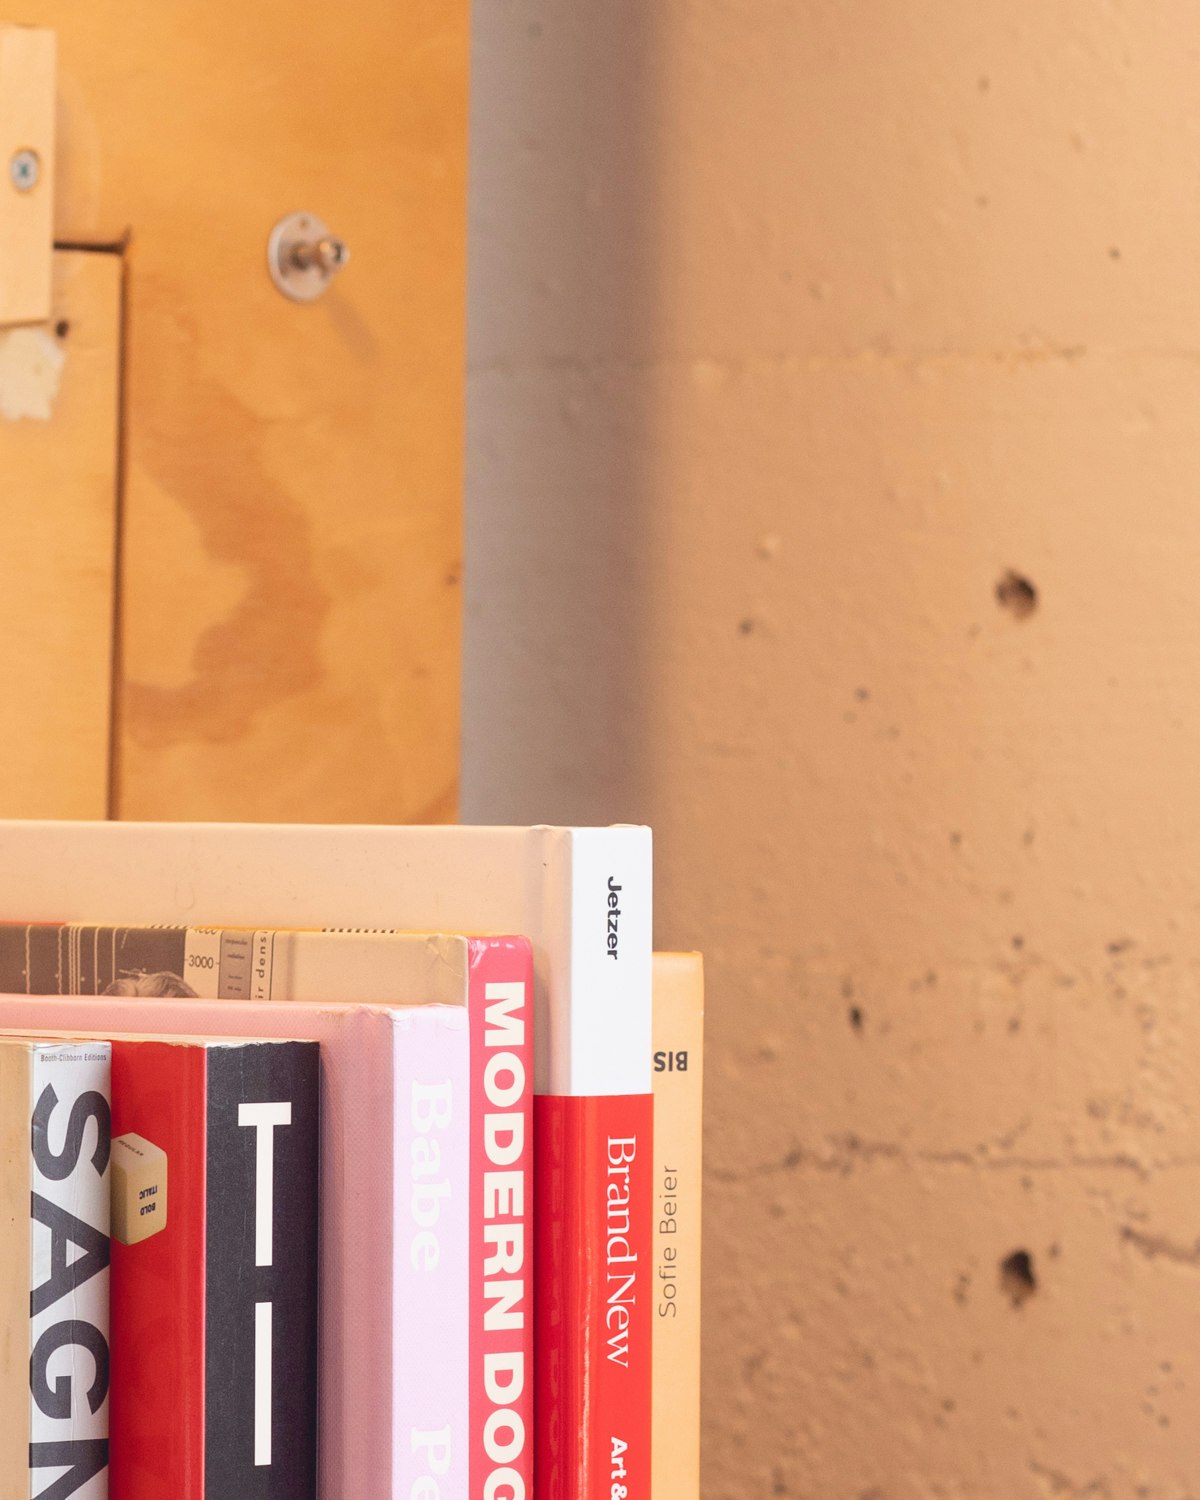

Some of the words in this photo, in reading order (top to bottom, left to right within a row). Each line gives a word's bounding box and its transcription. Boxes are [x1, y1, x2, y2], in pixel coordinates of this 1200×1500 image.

[607, 876, 622, 960] Jetzer
[189, 955, 214, 969] 3000
[41, 1054, 82, 1062] Booth-Clibborn
[84, 1053, 107, 1062] Editions
[653, 1051, 688, 1073] BIS
[411, 1078, 454, 1272] Babe
[483, 981, 526, 1331] MODERN
[139, 1185, 158, 1200] ITALIC
[140, 1202, 156, 1216] BOLD
[606, 1134, 637, 1264] Brand
[659, 1166, 677, 1234] Beier
[658, 1247, 677, 1318] Sofie
[606, 1272, 636, 1368] New
[611, 1437, 628, 1479] Art
